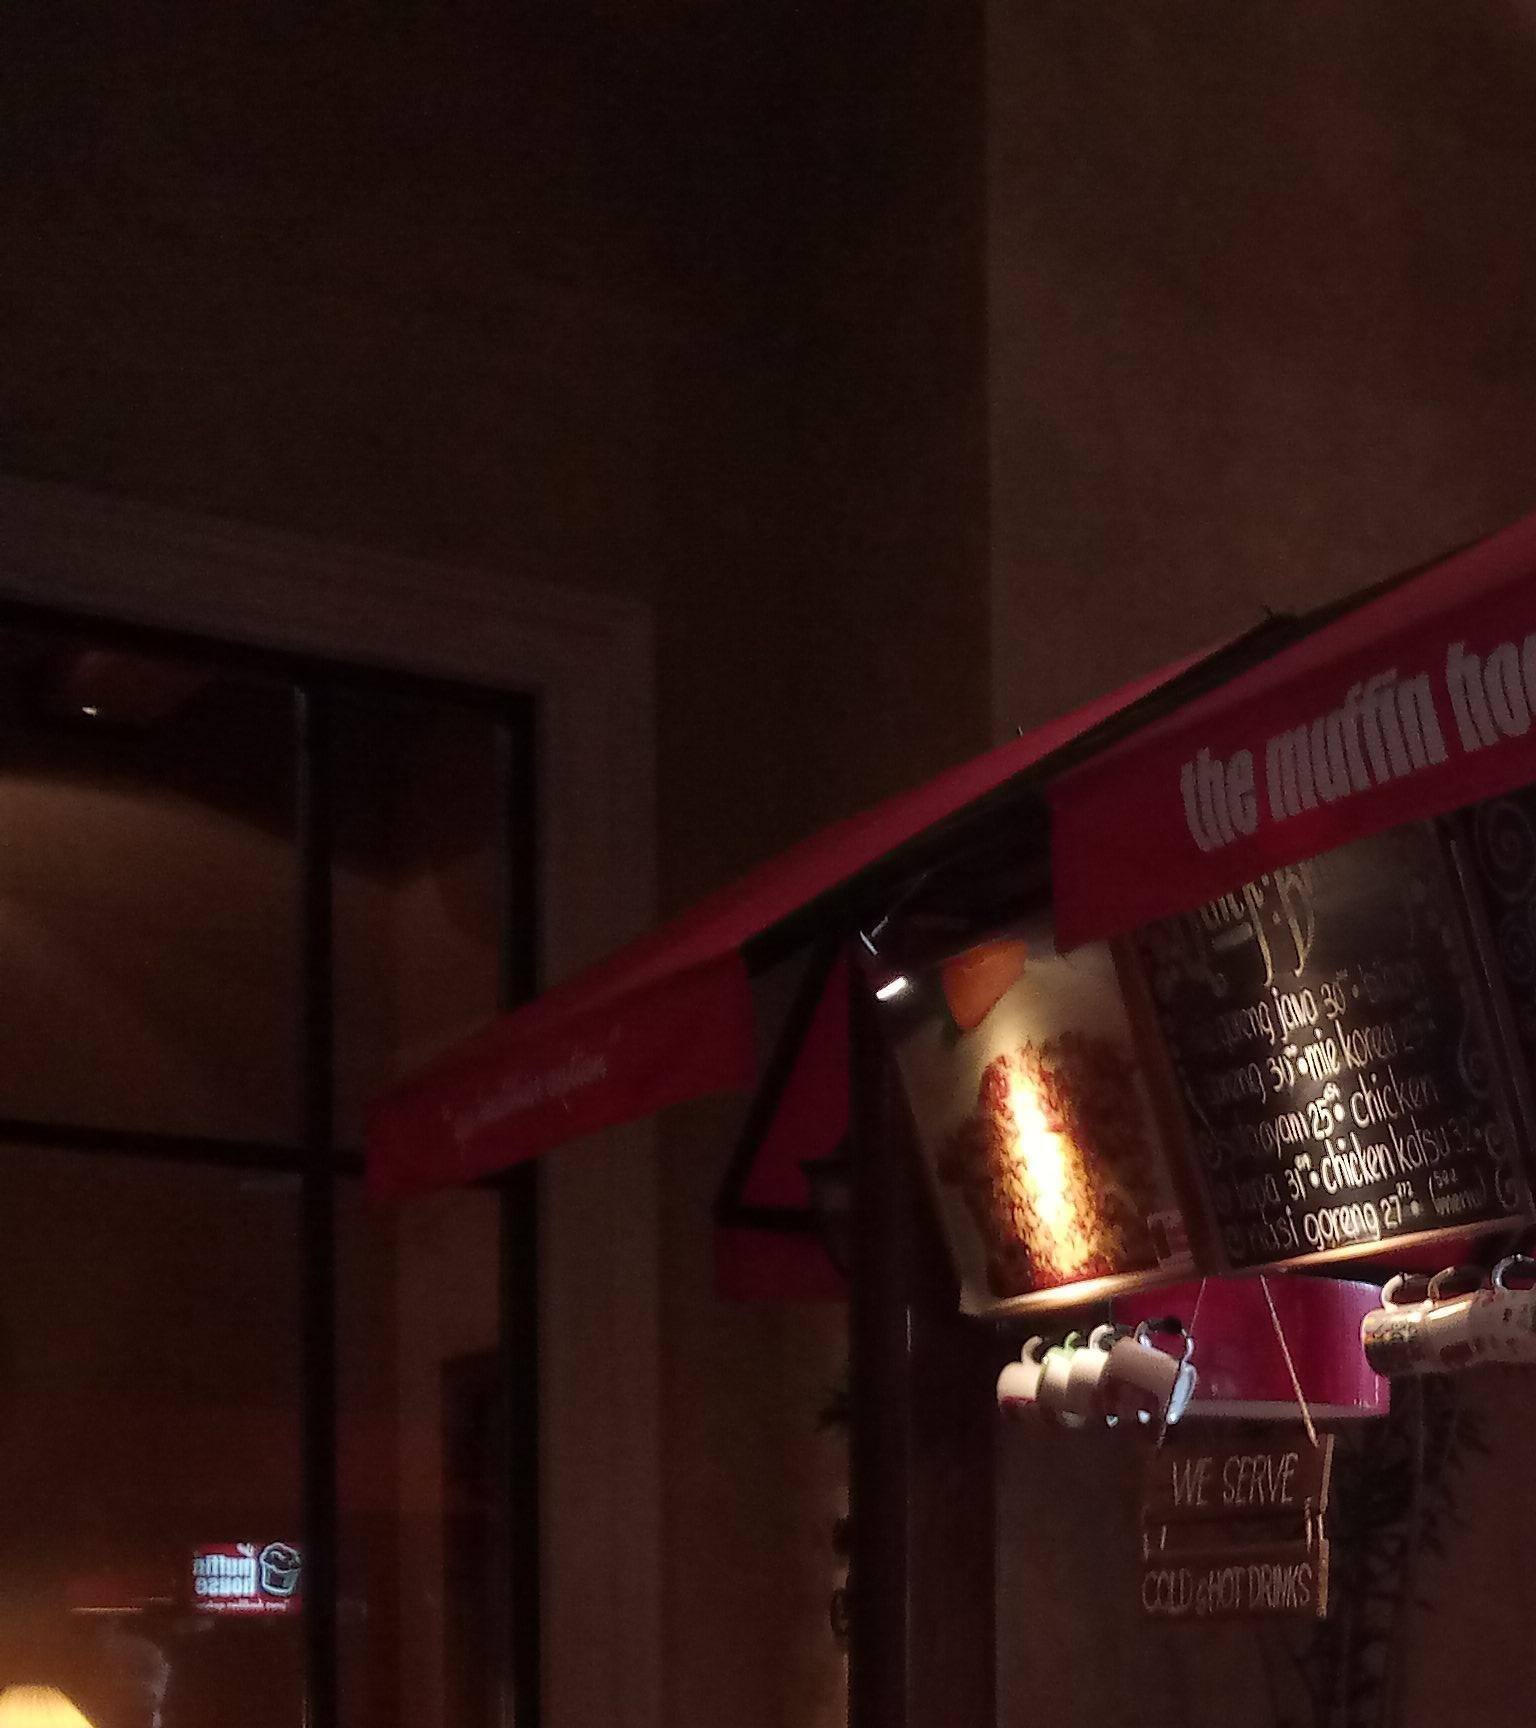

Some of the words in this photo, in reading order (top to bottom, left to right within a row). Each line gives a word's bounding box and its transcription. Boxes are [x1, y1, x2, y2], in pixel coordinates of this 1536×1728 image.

[1181, 746, 1260, 853] the
[1264, 667, 1451, 822] muffin
[1271, 986, 1320, 1044] java
[1350, 1064, 1441, 1129] chicken
[1321, 1130, 1397, 1194] chicken
[1303, 1194, 1383, 1253] goreng
[1171, 1455, 1215, 1507] WE
[1222, 1451, 1300, 1506] SERVE
